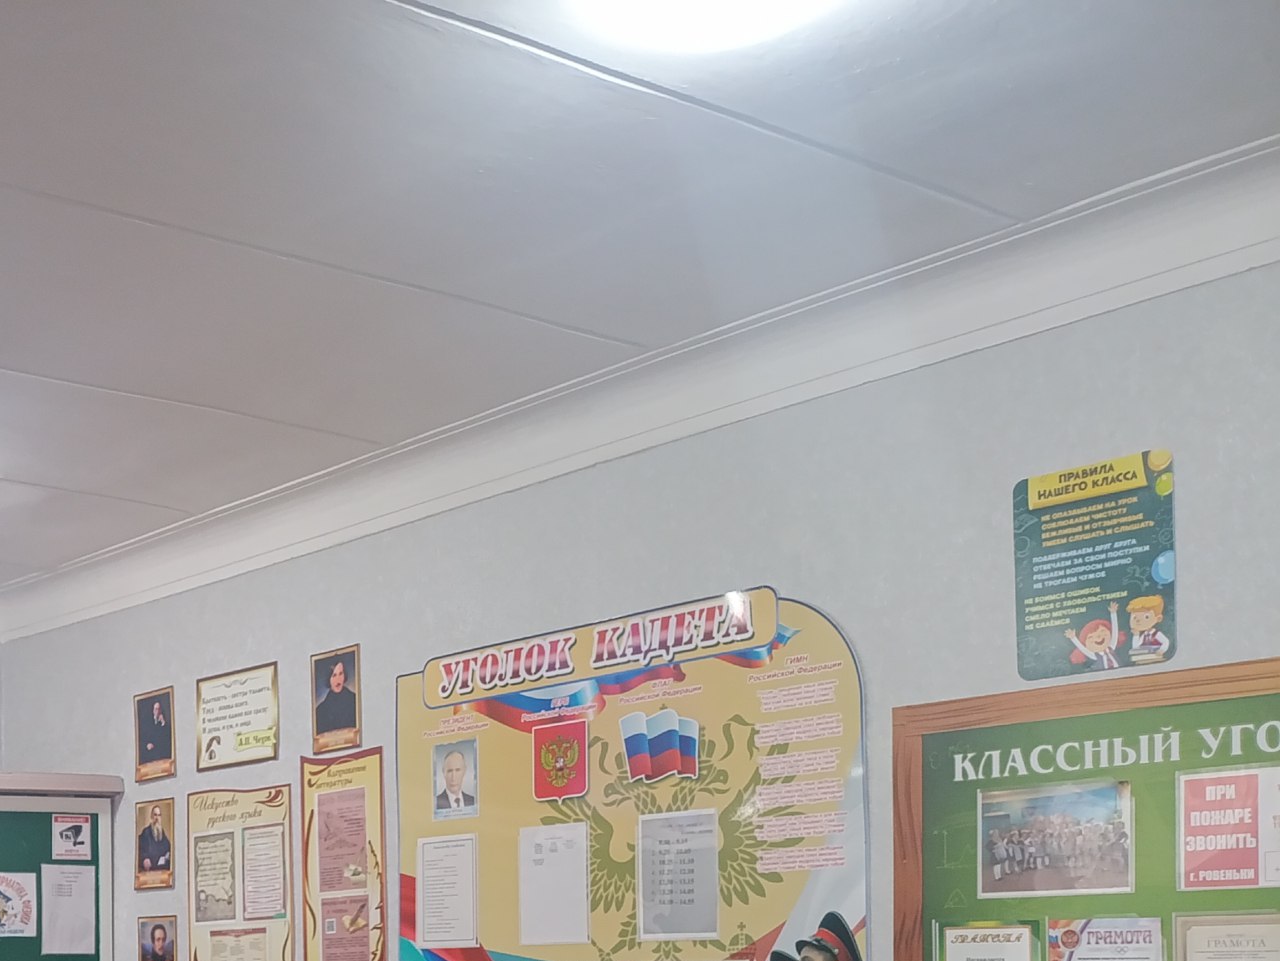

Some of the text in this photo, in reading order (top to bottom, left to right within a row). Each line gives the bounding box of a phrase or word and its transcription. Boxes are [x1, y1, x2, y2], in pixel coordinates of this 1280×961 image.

[1058, 463, 1115, 484] ПРАВИЛА
[1037, 470, 1138, 500] НАШЕГО КЛАССА
[1091, 508, 1127, 522] ЧИСТОТУ
[1114, 521, 1155, 534] СЛЫШАТЬ
[1113, 539, 1137, 549] ДРУГА
[1032, 545, 1150, 572] ОТВЕЧАЕМ ЗА СВОИ ПОСТУПКИ
[1032, 570, 1065, 581] РЕШАЕМ
[1066, 563, 1103, 575] ВОПРОСЫ
[1033, 571, 1106, 590] НЕ ТРОГАЕМ ЧУЖОЕ
[1067, 586, 1101, 598] ОШИБОК
[1024, 606, 1087, 622] СМЕЛО МЕЧТАЕМ
[1024, 623, 1034, 631] НЕ
[439, 602, 752, 696] УГОЛОК КАДЕТА
[785, 655, 808, 666] ГИМН
[748, 661, 842, 683] Российской Федерации
[651, 679, 673, 689] ФЛАГ
[619, 685, 702, 704] Российской Федерации
[521, 704, 597, 722] Российской Федерации
[456, 722, 489, 732] Федерации
[953, 726, 1181, 782] КЛАССНЫЙ
[1205, 783, 1236, 801] ПРИ
[1190, 808, 1253, 827] ПОЖАРЕ
[1185, 831, 1257, 852] ЗВОНИТЬ
[1189, 872, 1198, 882] г.
[1087, 930, 1152, 945] ГРАМОТА
[1207, 939, 1267, 948] ГРАМОТА
